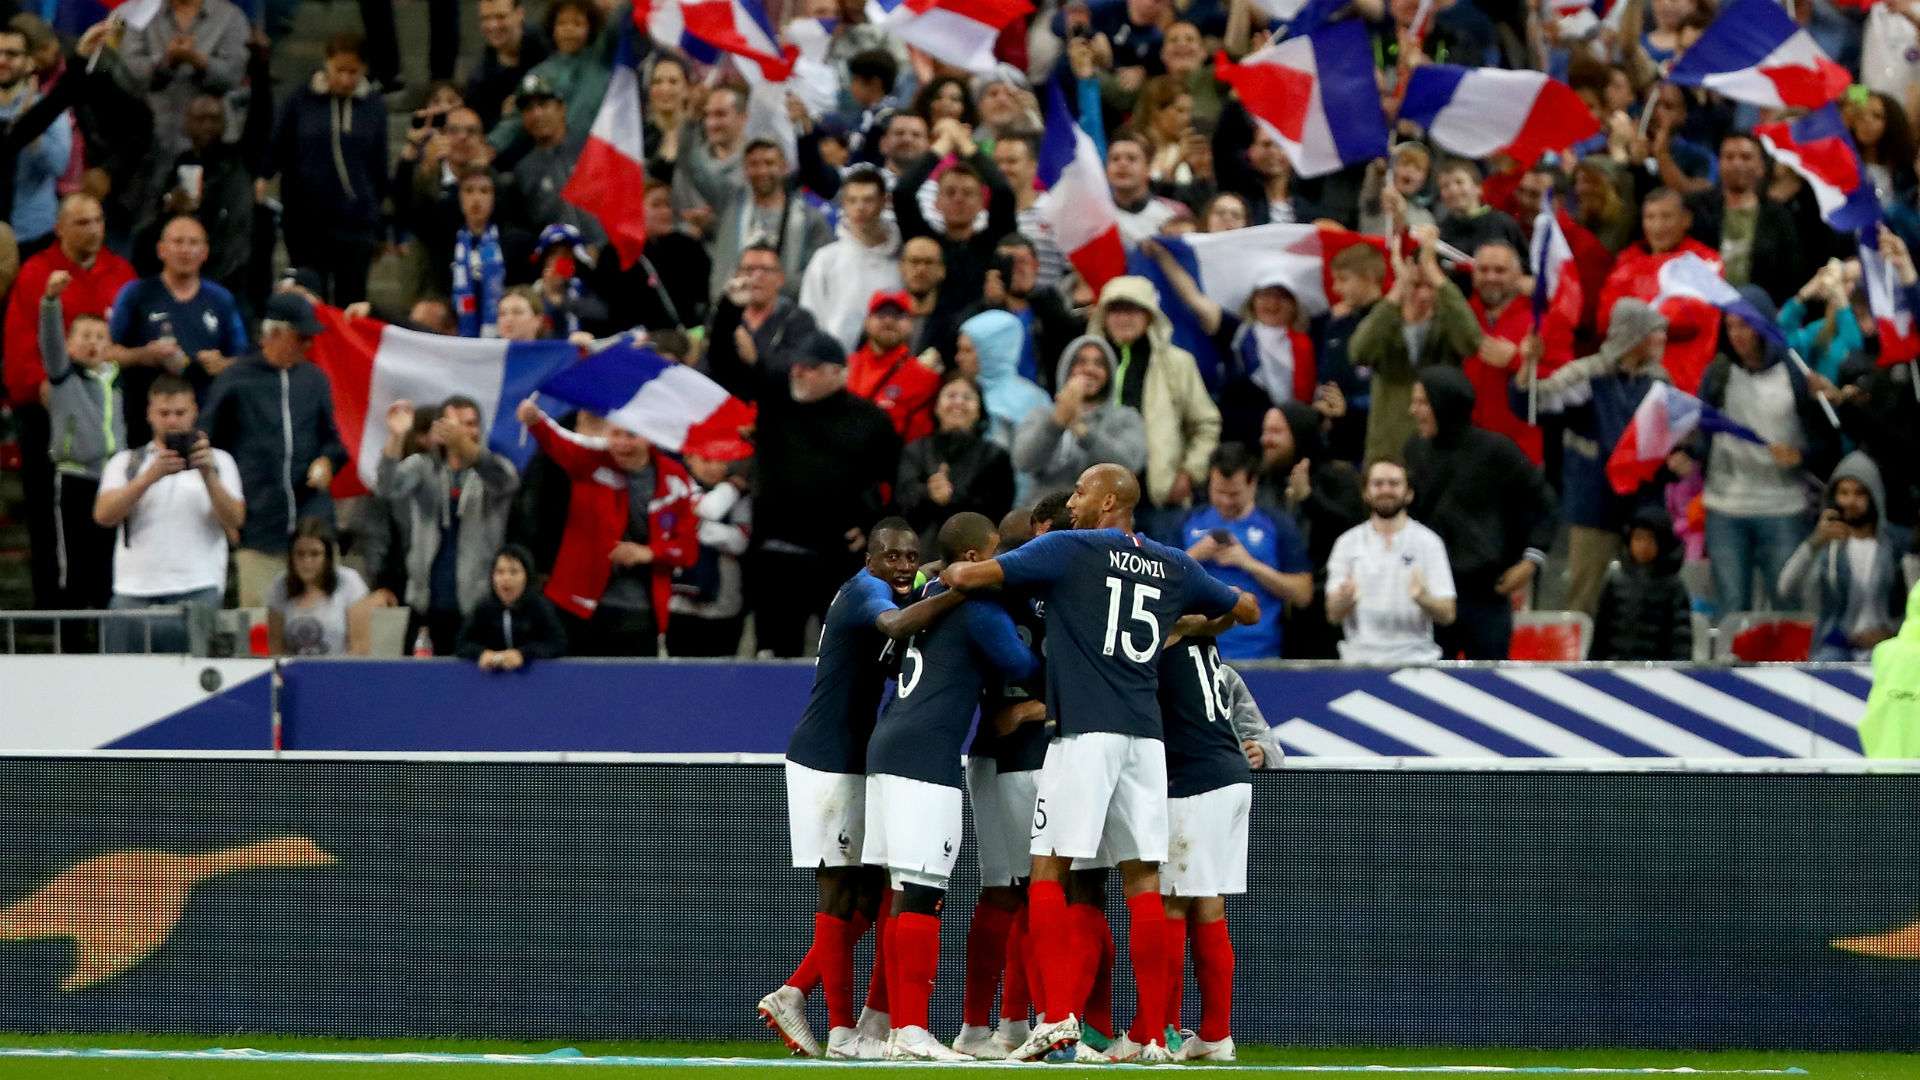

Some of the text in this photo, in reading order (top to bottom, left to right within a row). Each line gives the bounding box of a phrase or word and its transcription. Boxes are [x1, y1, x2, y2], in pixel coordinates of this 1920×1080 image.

[1109, 550, 1166, 579] NZONZI
[1102, 575, 1162, 664] 15
[1188, 644, 1232, 722] 18
[1034, 797, 1048, 830] 5
